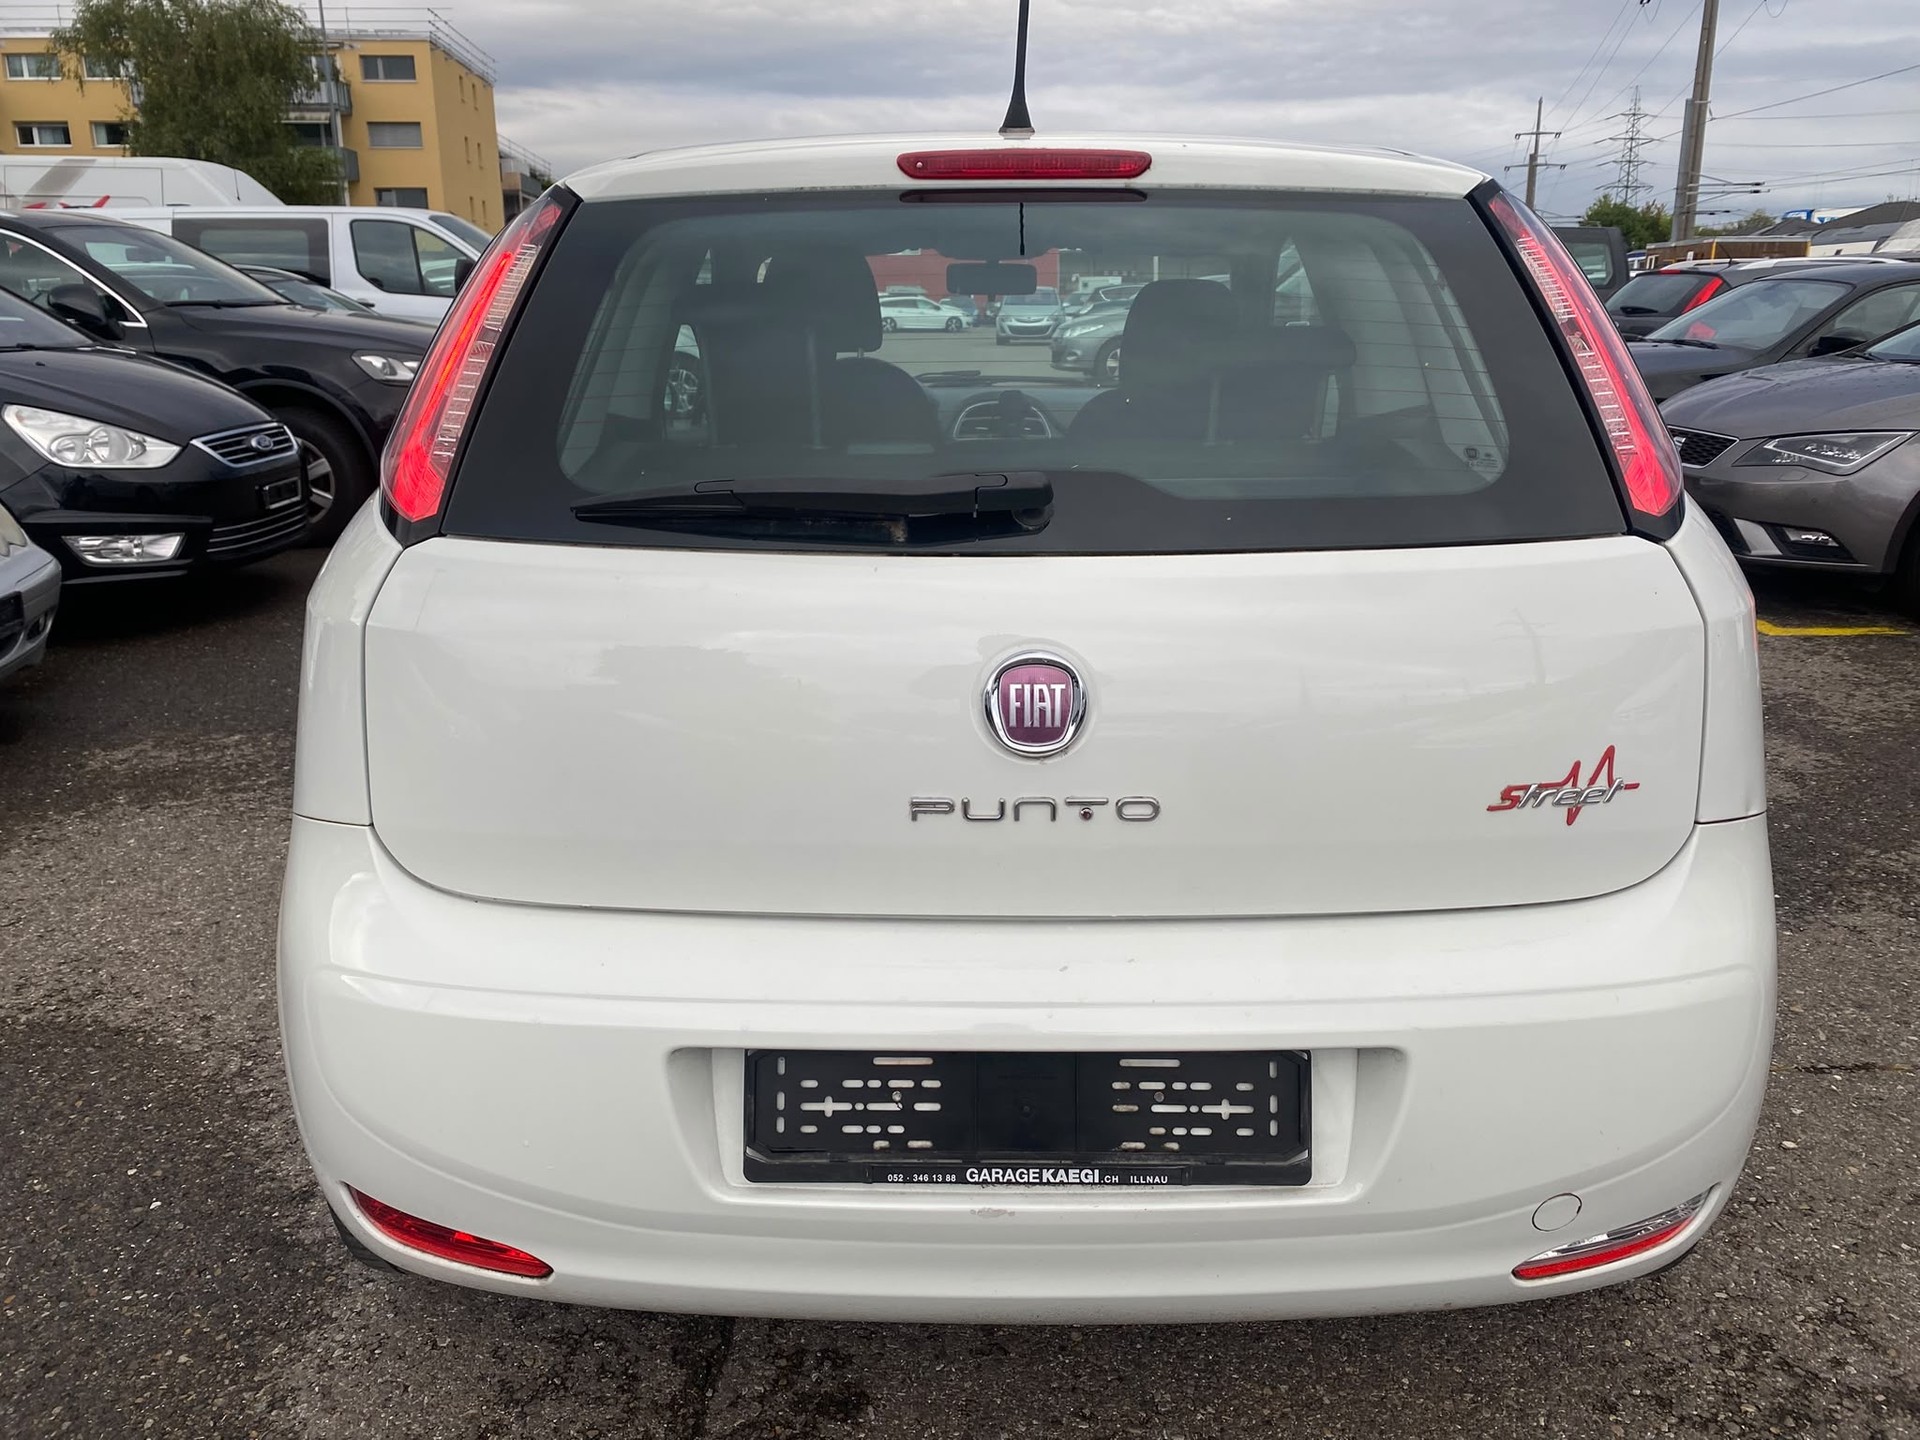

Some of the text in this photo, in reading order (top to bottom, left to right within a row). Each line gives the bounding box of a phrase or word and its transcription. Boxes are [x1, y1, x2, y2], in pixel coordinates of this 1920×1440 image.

[1009, 683, 1066, 728] FIAT
[909, 796, 1160, 822] PUNTO
[887, 1174, 904, 1182] 052
[912, 1174, 929, 1182] 346
[932, 1174, 942, 1182] 13
[945, 1174, 956, 1182] 88
[1130, 1175, 1168, 1184] ILLNAU
